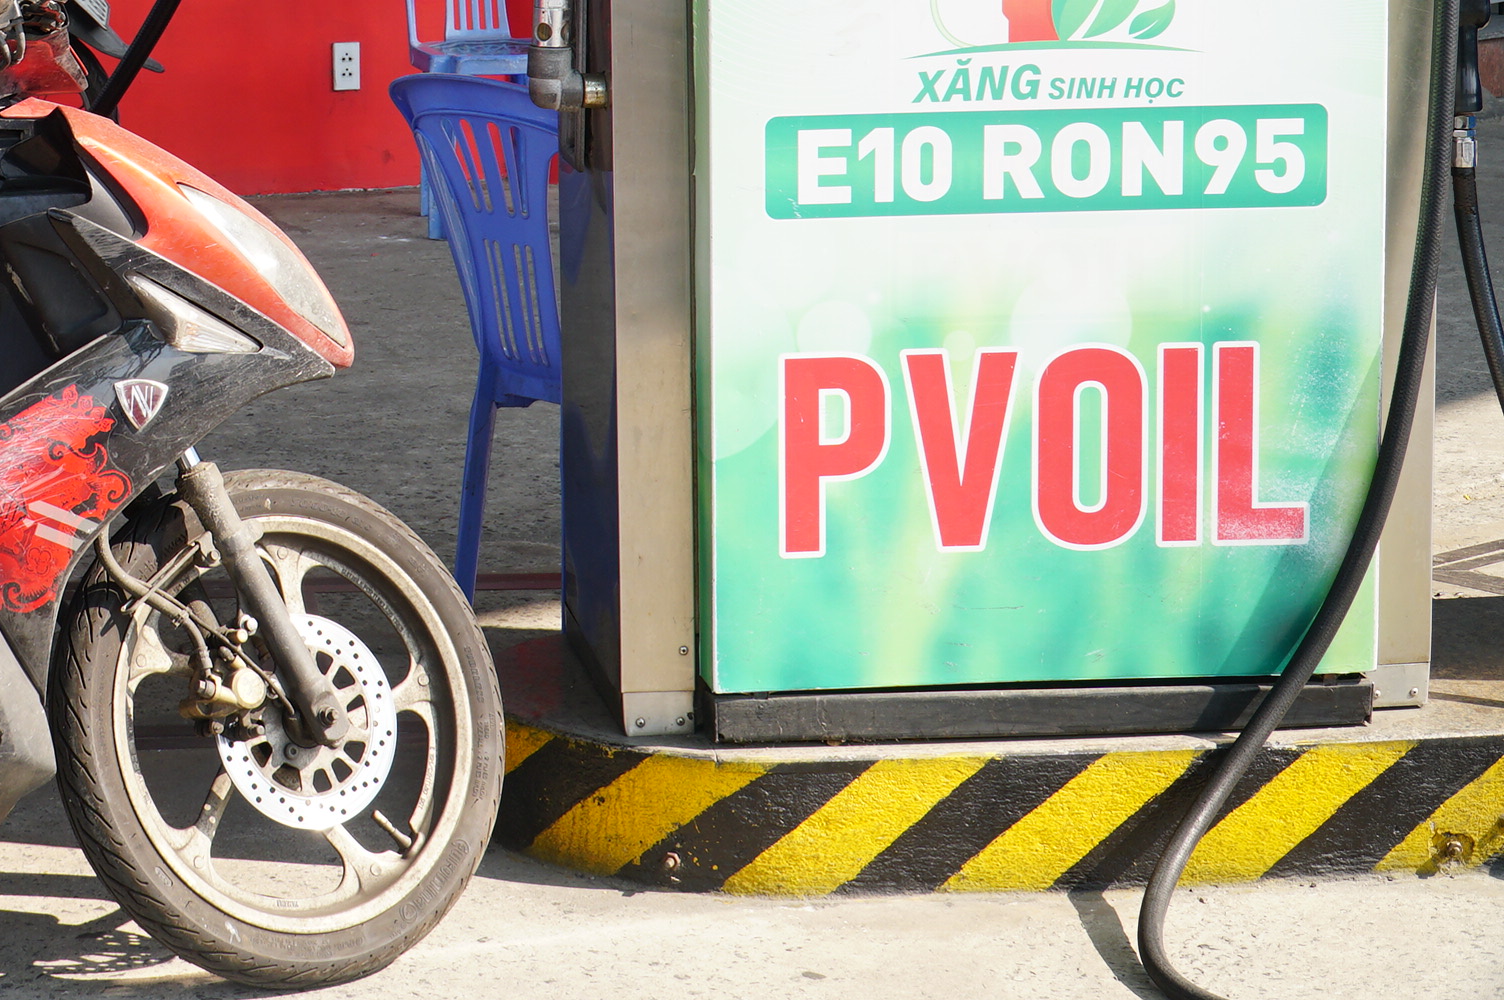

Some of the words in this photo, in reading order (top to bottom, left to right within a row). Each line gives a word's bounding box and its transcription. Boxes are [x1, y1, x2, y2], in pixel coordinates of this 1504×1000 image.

[912, 58, 1042, 104] XĂNG
[1048, 78, 1116, 99] SINH
[1123, 77, 1185, 104] HỌC
[798, 125, 952, 205] E10
[779, 341, 1310, 559] PVOIL
